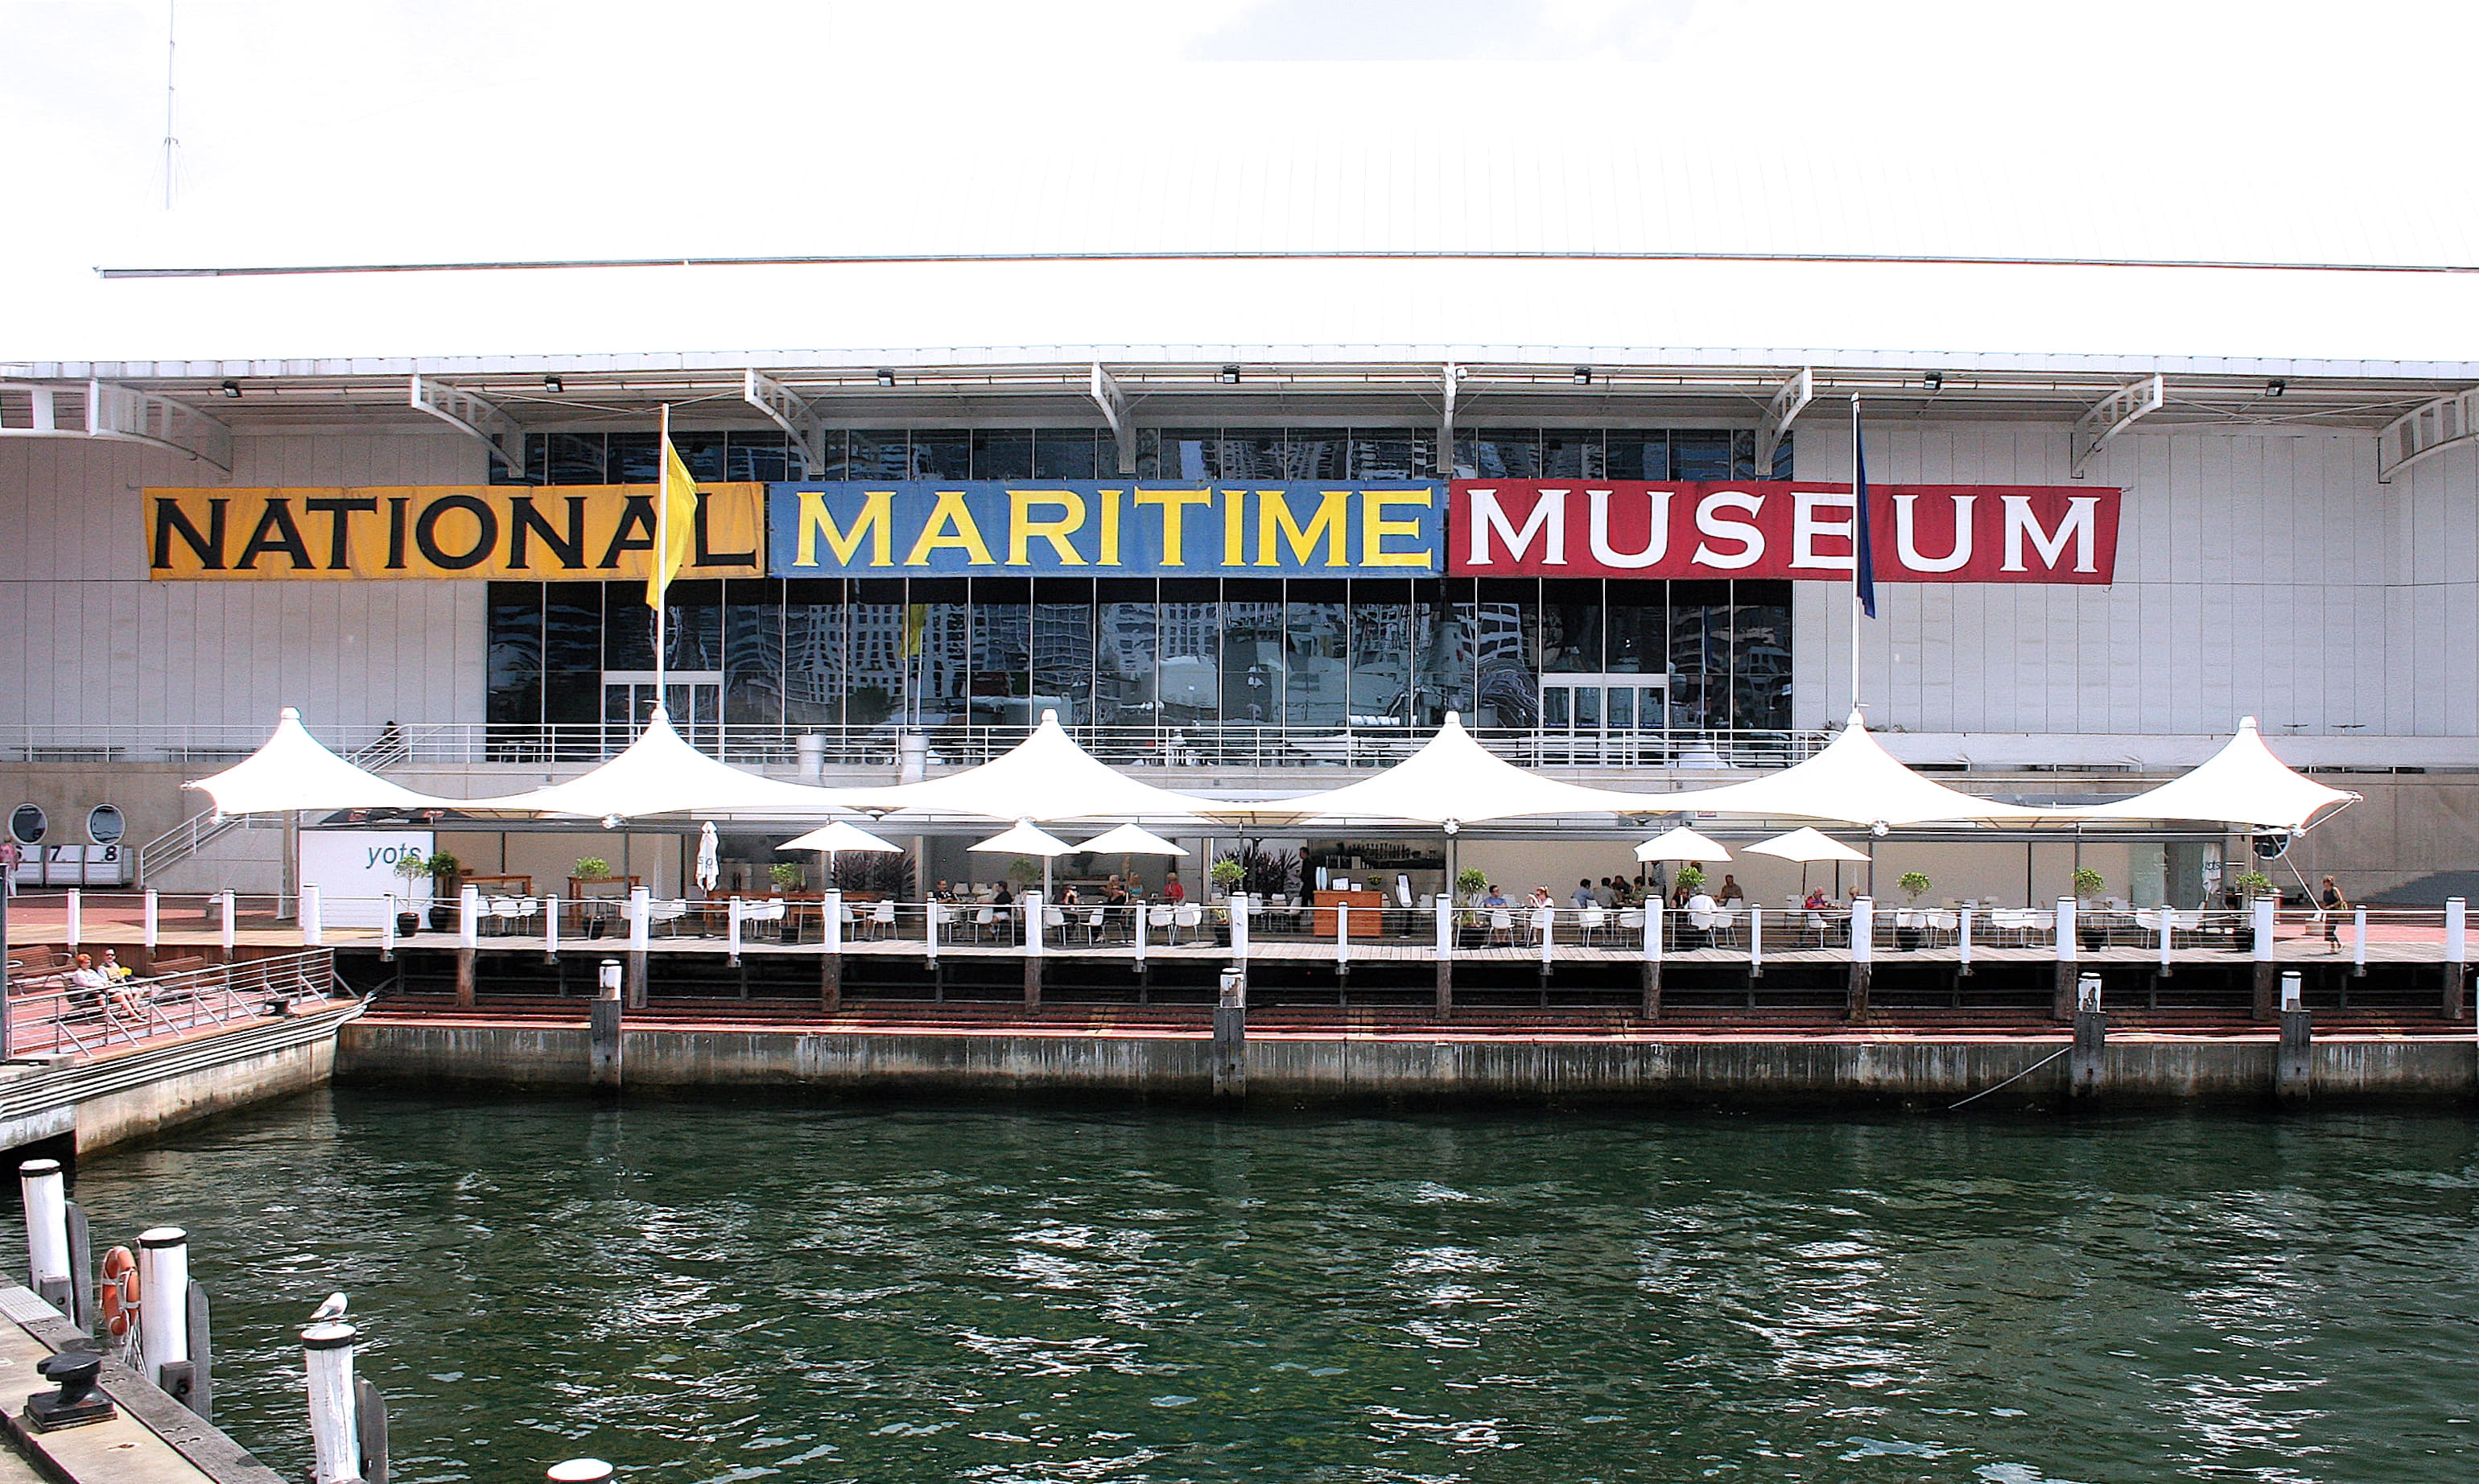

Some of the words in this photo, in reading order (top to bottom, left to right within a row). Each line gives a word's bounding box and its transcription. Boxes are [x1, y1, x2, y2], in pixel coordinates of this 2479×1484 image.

[151, 492, 758, 571] NATIONAL
[791, 486, 1433, 568] MARITIME
[1466, 488, 2102, 574] MUSEUM
[50, 845, 62, 861] 7
[104, 845, 118, 862] 8
[365, 842, 422, 869] yots
